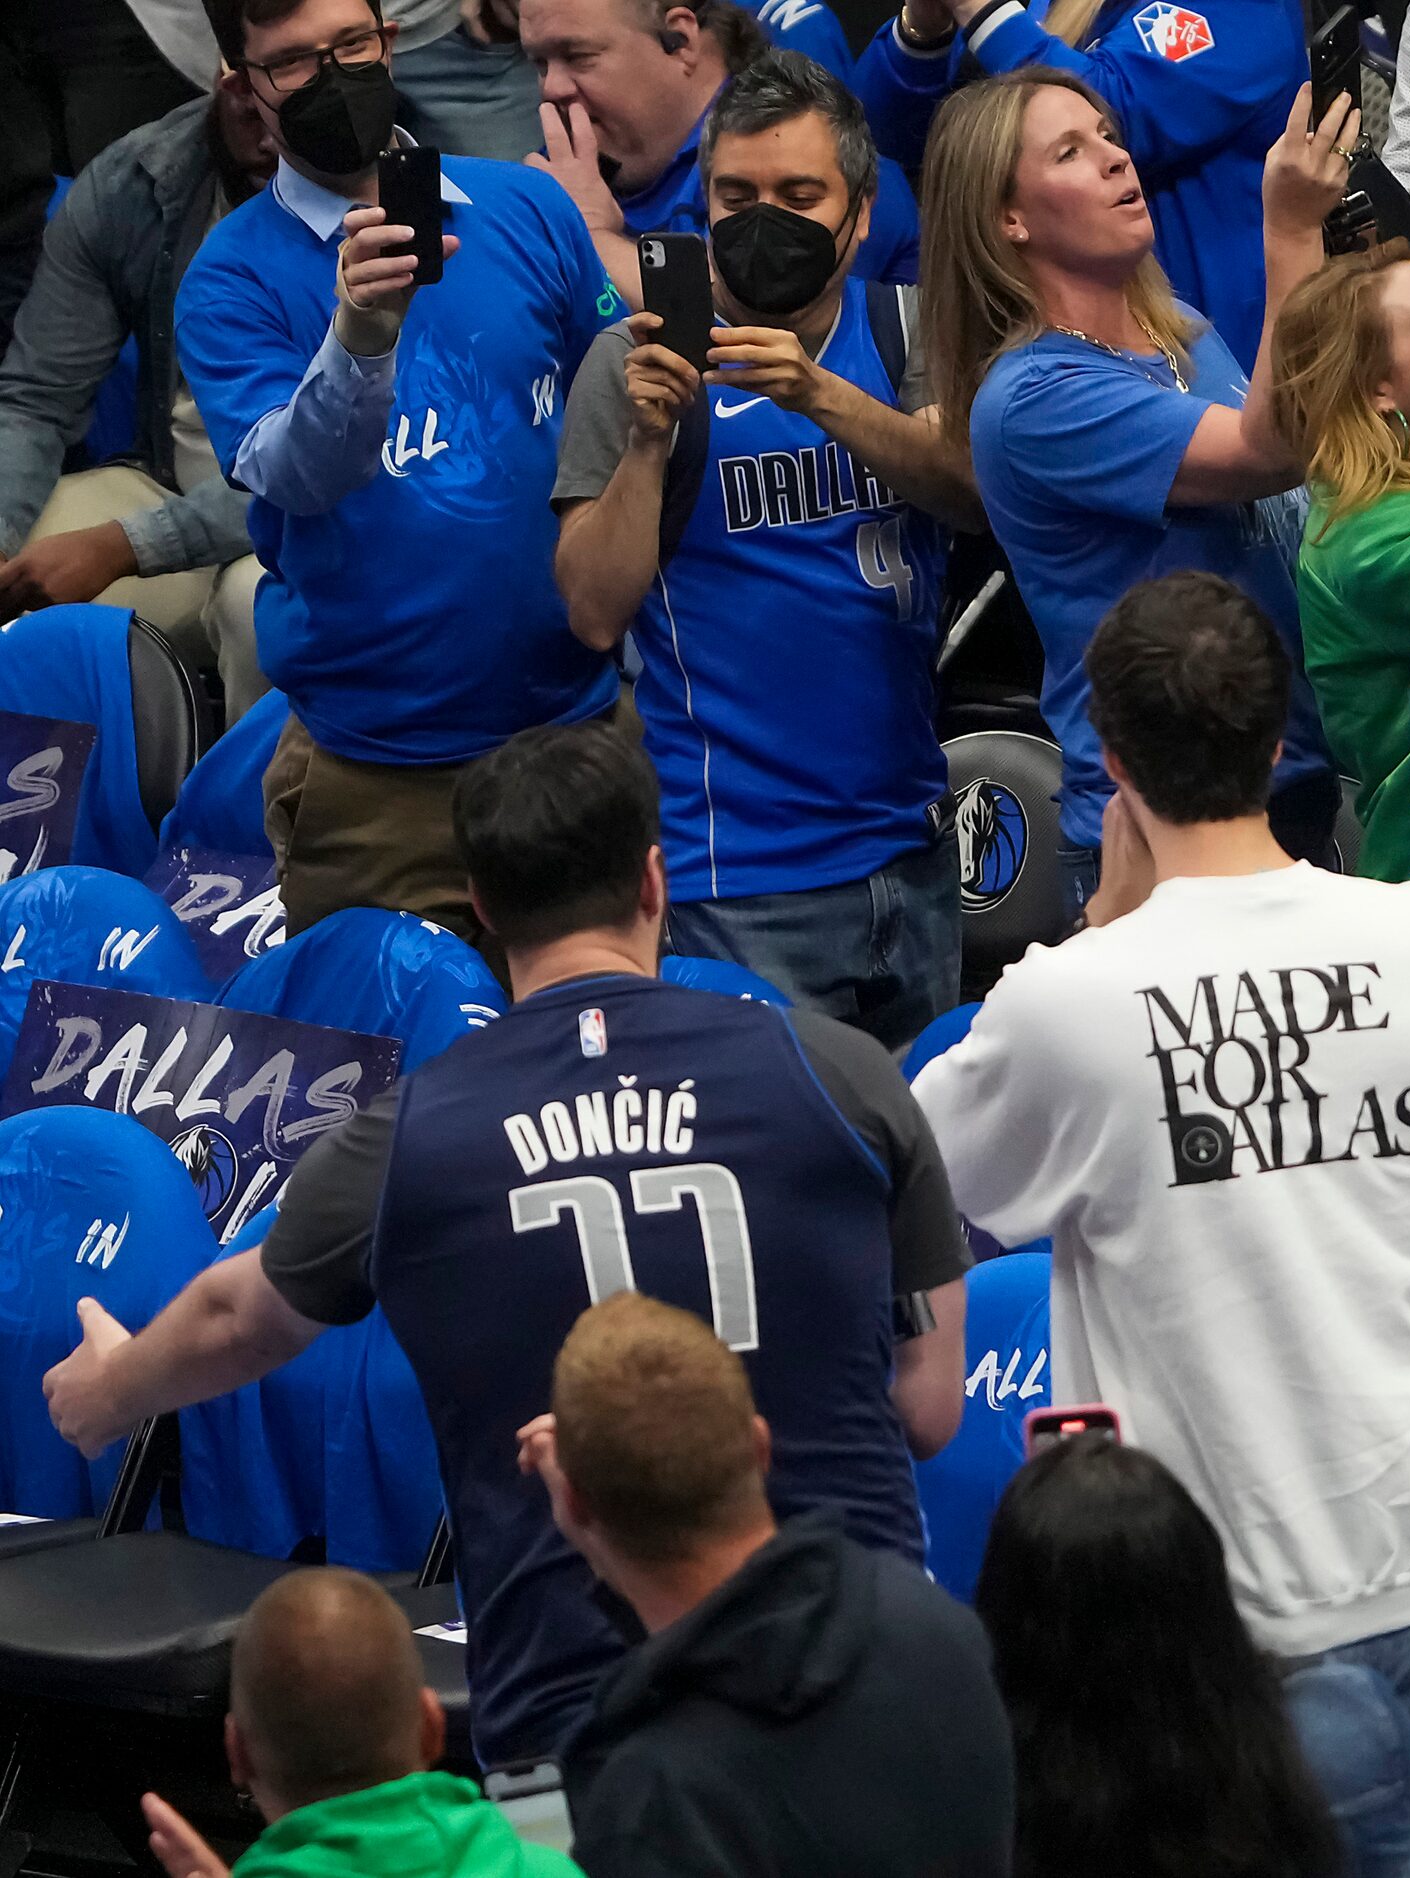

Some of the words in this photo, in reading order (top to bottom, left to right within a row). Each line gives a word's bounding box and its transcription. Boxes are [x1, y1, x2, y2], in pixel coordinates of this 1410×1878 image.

[1180, 20, 1199, 44] 75
[718, 441, 905, 533] DALLA
[97, 924, 160, 971] IN
[170, 873, 287, 958] DA
[1134, 962, 1390, 1048] MADE
[31, 1015, 364, 1162] DALLAS
[1146, 1033, 1328, 1120] FOR
[503, 1074, 697, 1176] DONČIĆ
[75, 1211, 130, 1270] IN
[508, 1163, 759, 1352] 77
[965, 1347, 1047, 1411] ALL
